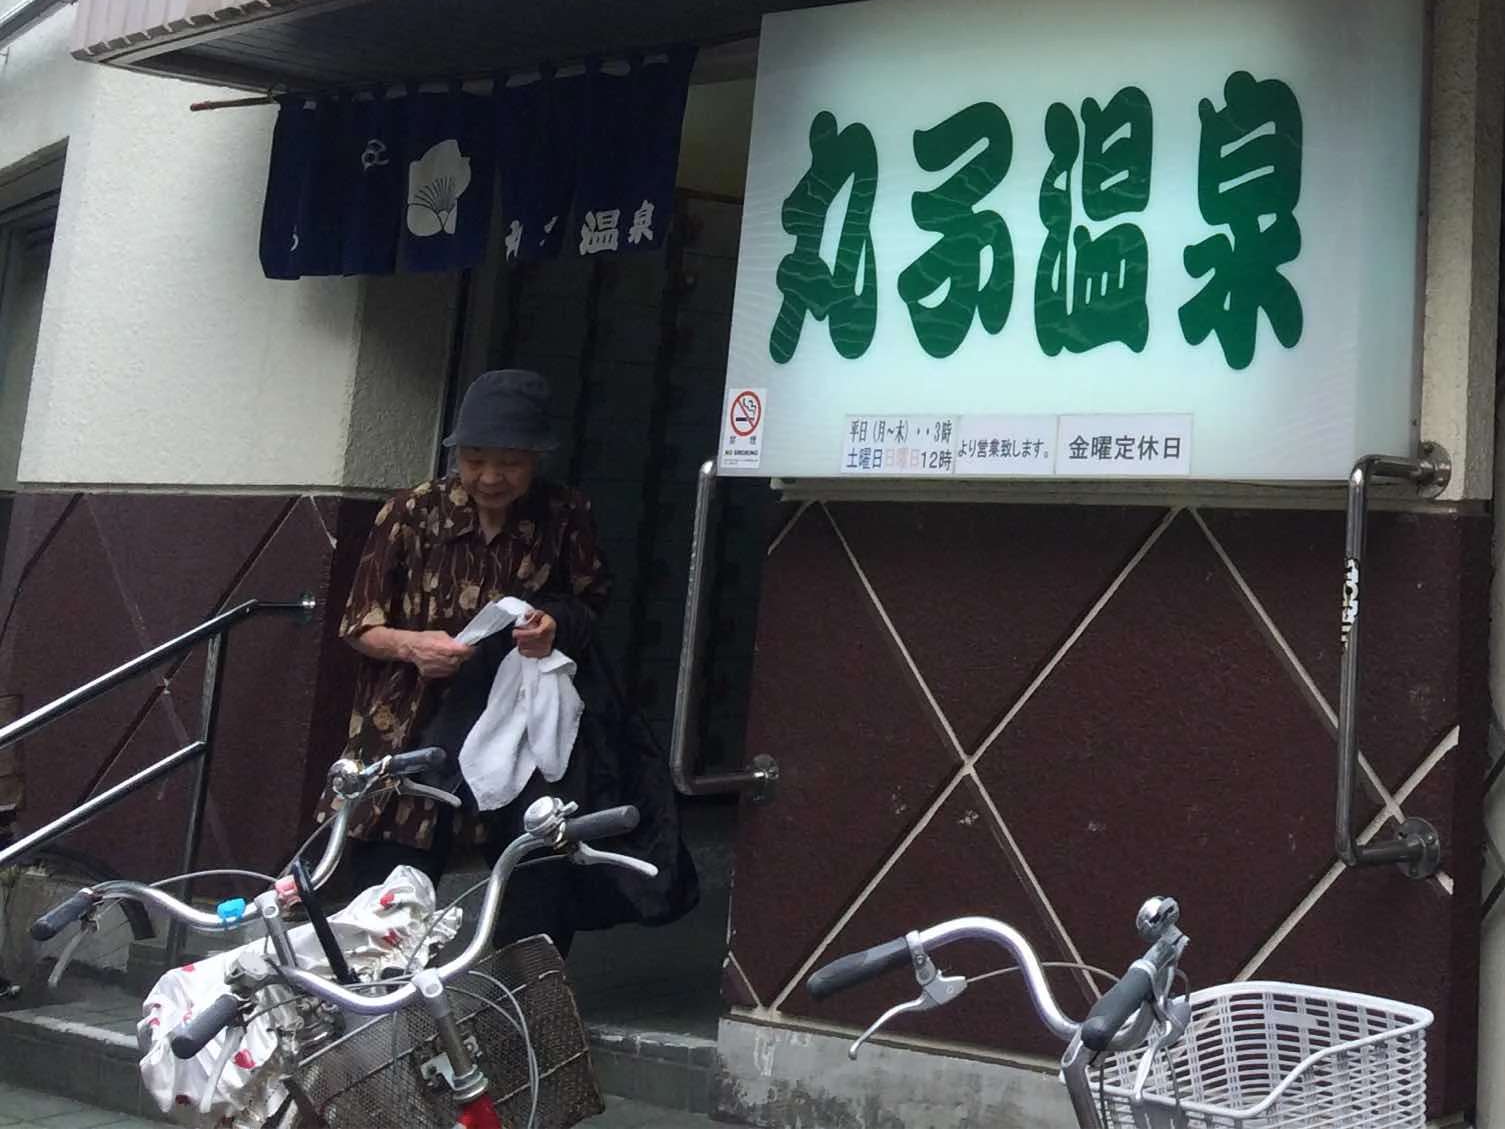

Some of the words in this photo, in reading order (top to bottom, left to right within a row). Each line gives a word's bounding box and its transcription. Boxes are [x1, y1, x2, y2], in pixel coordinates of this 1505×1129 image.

[768, 70, 1304, 370] 丸子温泉
[1068, 434, 1182, 461] 金曜定休日
